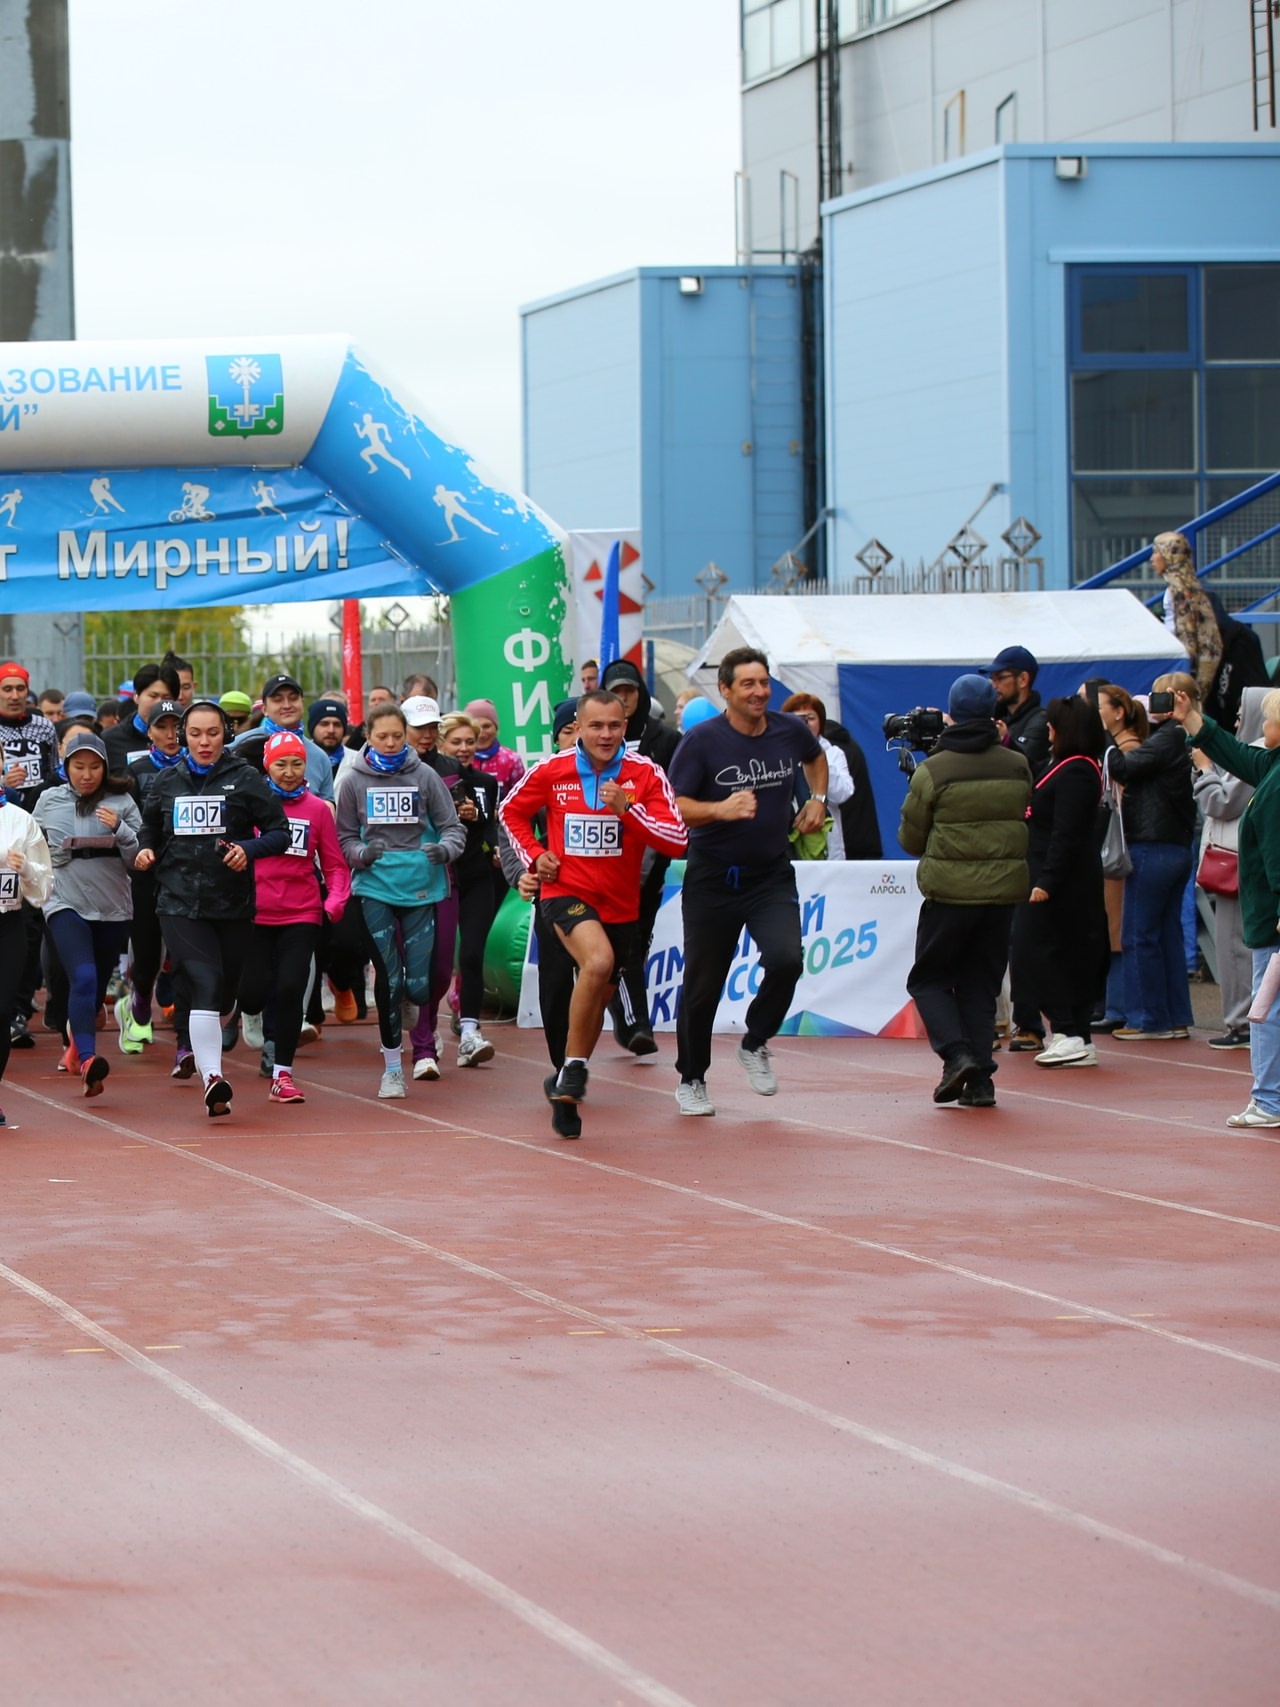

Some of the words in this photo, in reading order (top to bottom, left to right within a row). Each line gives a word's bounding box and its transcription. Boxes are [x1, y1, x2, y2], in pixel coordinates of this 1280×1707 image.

[57, 519, 350, 590] Мирный!
[714, 757, 793, 787] Confidential
[552, 783, 581, 791] LUKOIL
[178, 805, 221, 824] 407
[374, 796, 411, 814] 318
[570, 825, 616, 844] 355
[799, 920, 878, 980] 025
